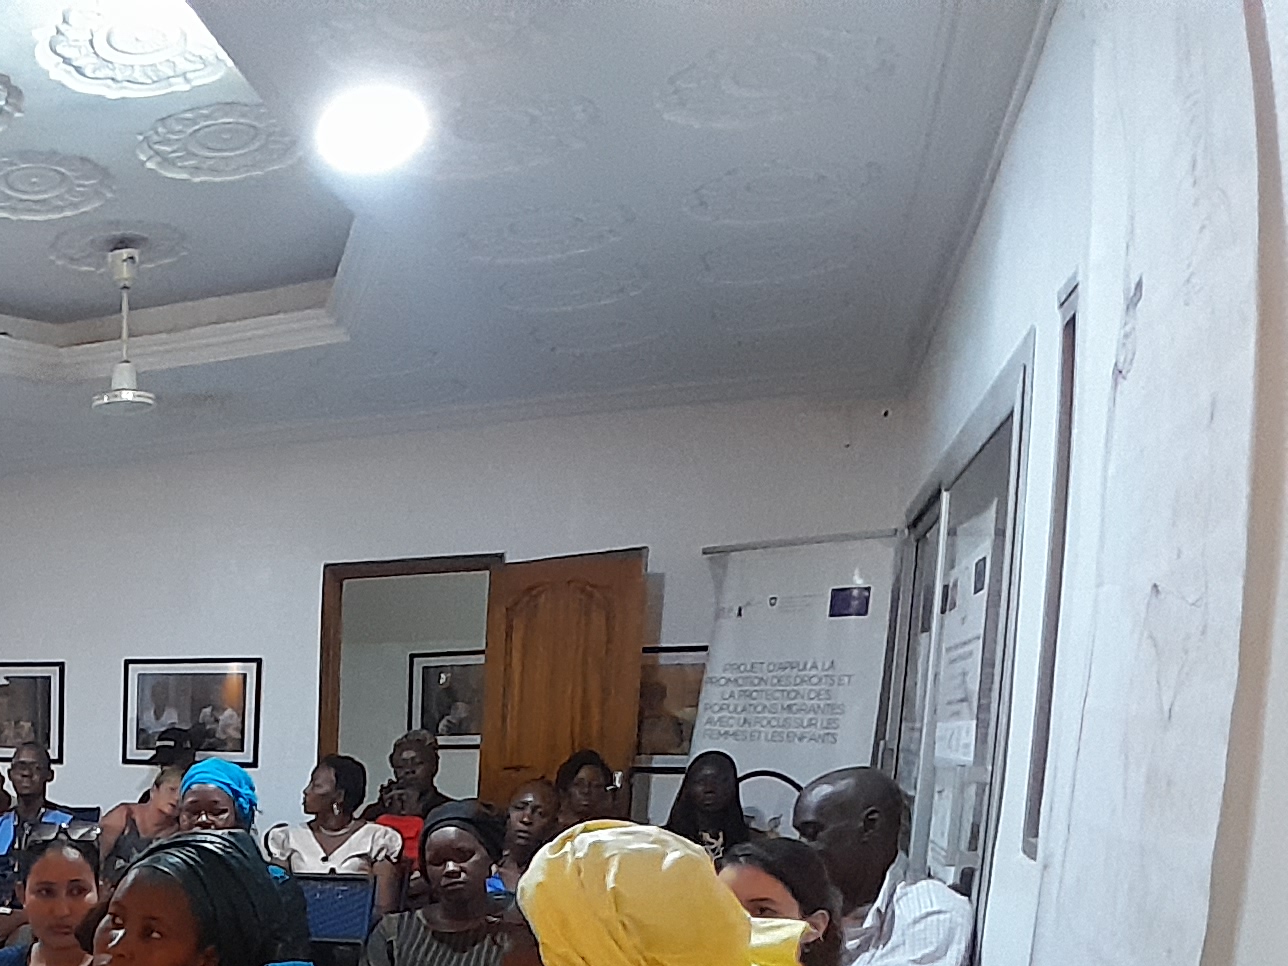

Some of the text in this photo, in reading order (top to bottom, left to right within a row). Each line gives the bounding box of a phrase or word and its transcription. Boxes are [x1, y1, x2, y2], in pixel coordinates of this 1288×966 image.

[771, 676, 792, 686] DES
[838, 674, 855, 686] ET
[808, 689, 832, 700] DES
[822, 718, 840, 729] LES
